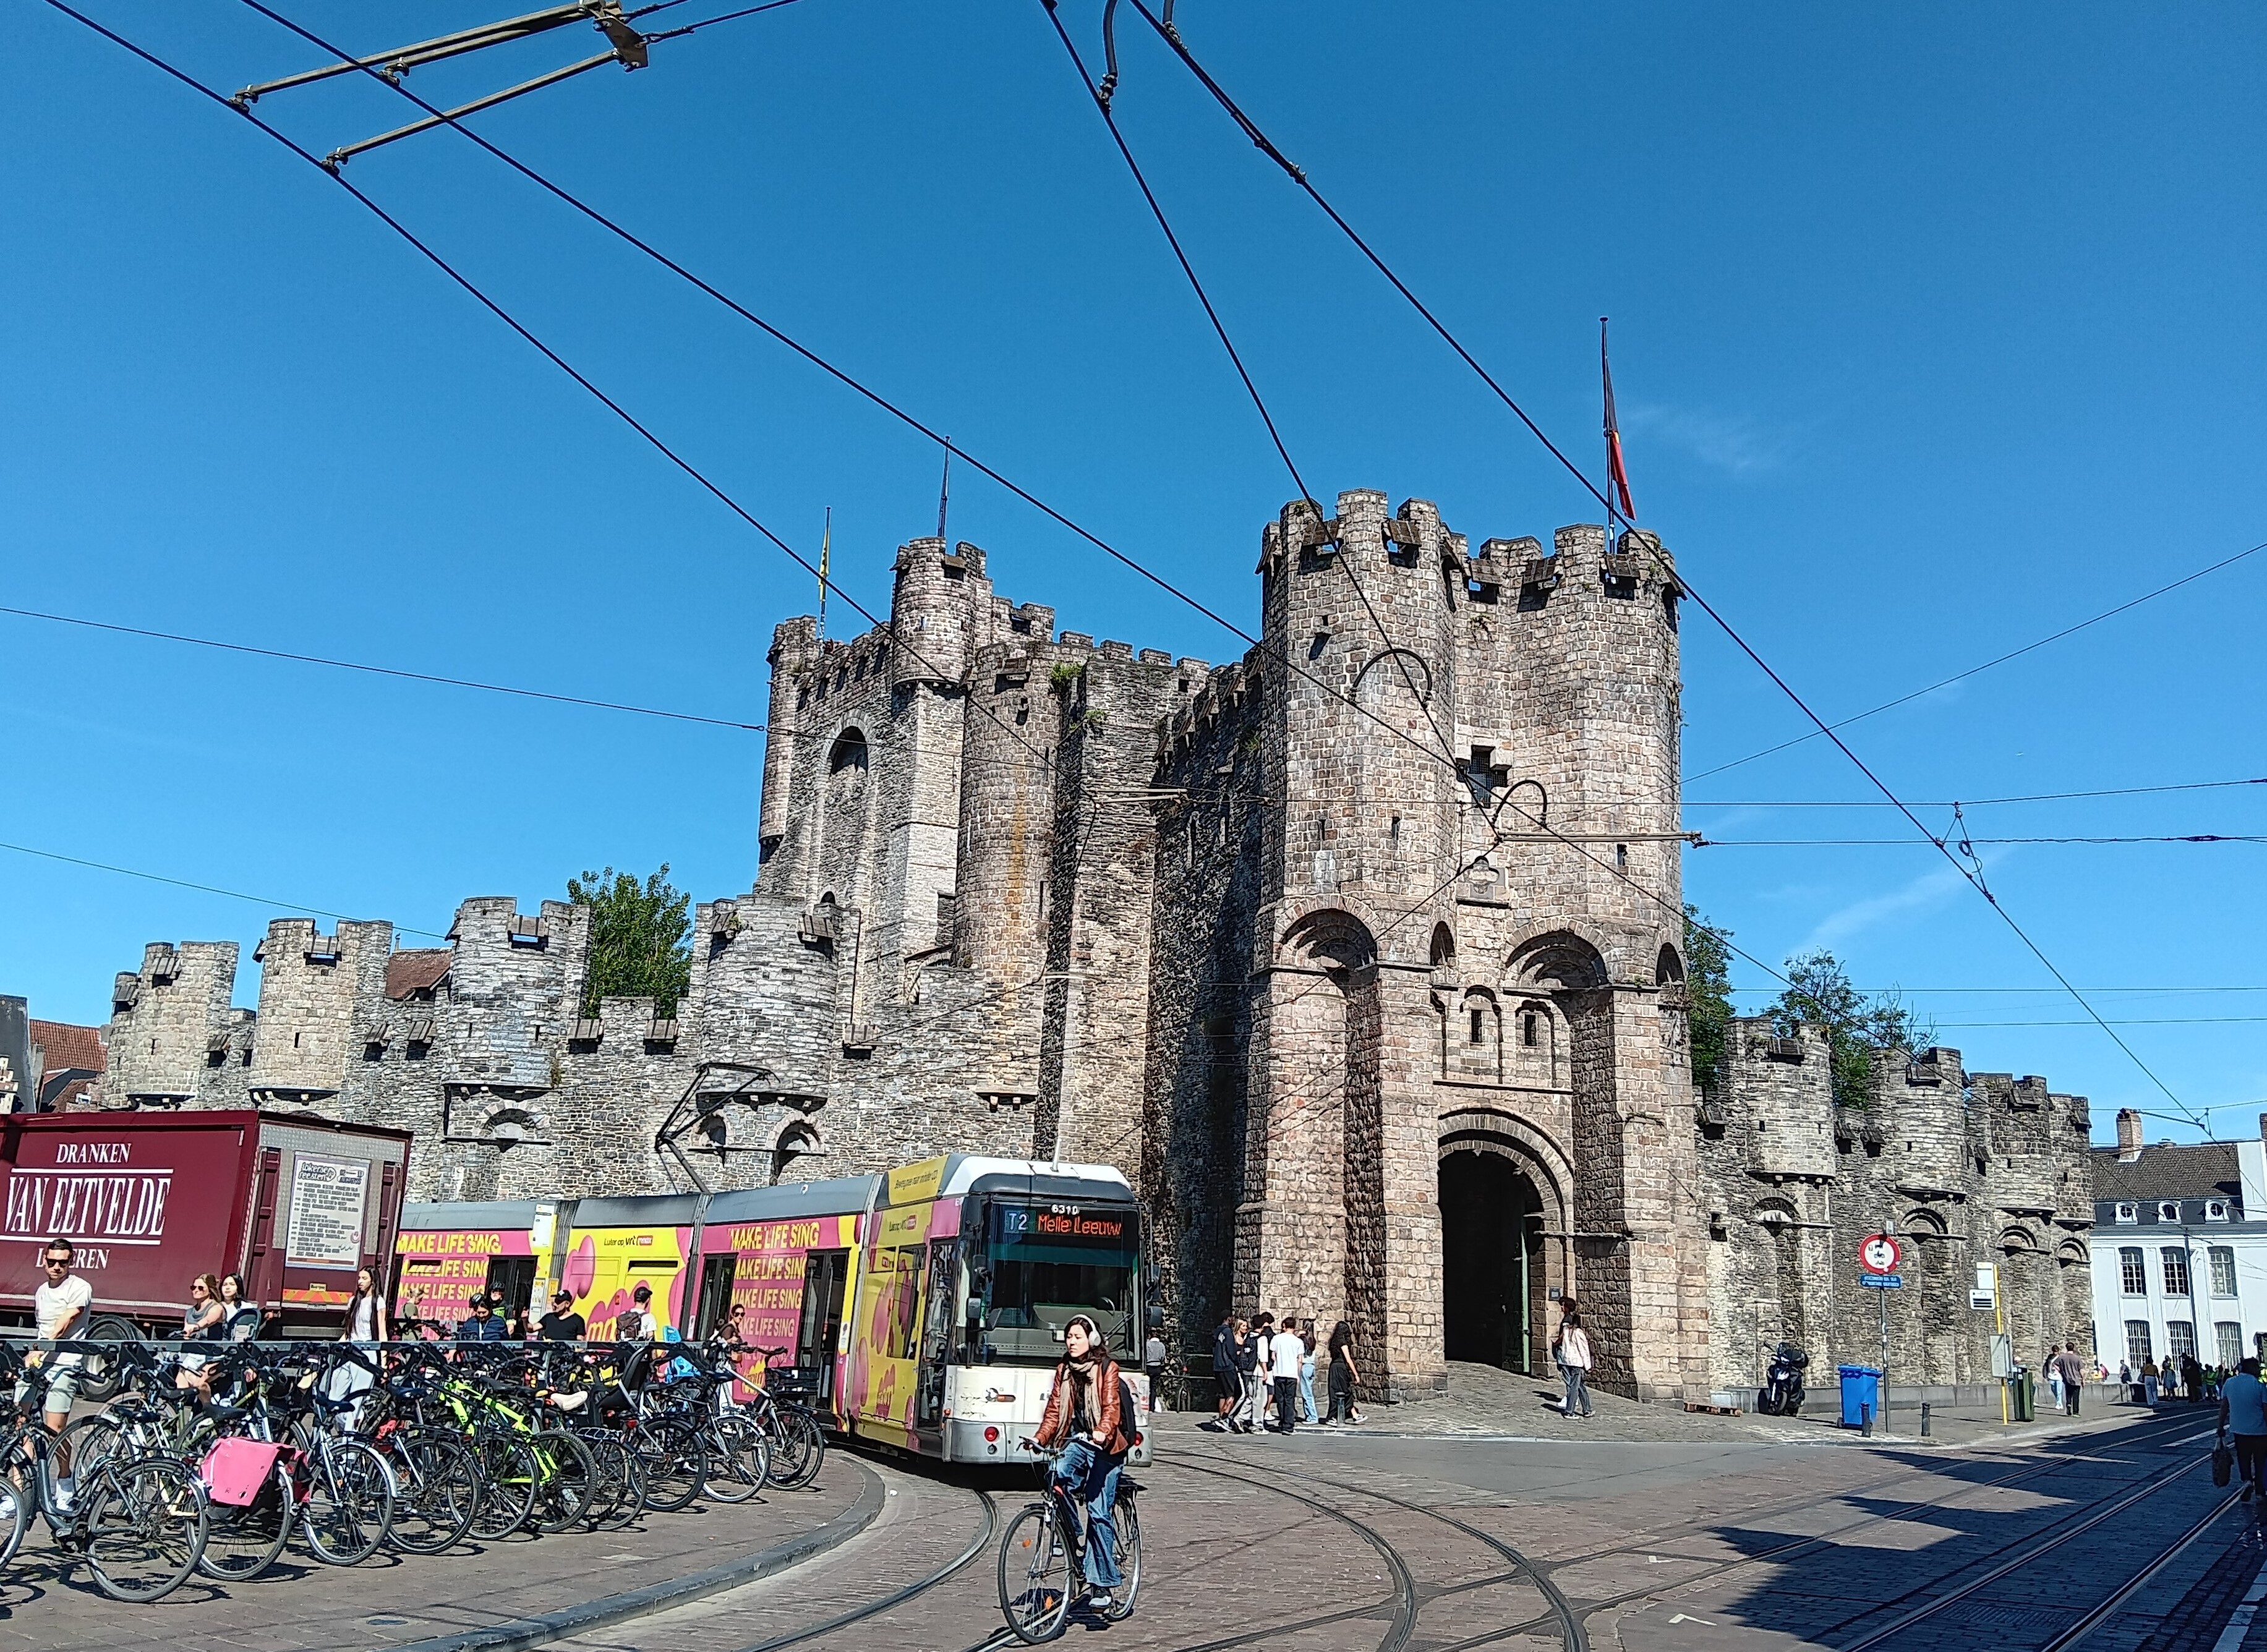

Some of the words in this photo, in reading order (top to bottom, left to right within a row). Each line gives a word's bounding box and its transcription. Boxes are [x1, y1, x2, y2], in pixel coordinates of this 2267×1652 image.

[56, 1143, 132, 1163] DRANKEN
[5, 1177, 49, 1233] VAN
[46, 1177, 171, 1235] EETVELDE
[1052, 1204, 1080, 1215] 6310
[1009, 1213, 1028, 1230] T2
[1038, 1214, 1071, 1233] Melle
[1074, 1216, 1122, 1235] Leeuw
[396, 1234, 436, 1254] MAKE
[437, 1234, 466, 1254] LIFE
[466, 1233, 503, 1254] SING
[730, 1227, 762, 1251] MAKE
[764, 1224, 789, 1250] LIFE
[790, 1222, 819, 1248] SING
[35, 1248, 110, 1269] LEREN
[761, 1258, 783, 1280] LIFE
[432, 1284, 456, 1300] LIFE
[731, 1288, 758, 1309] MAKE
[758, 1288, 779, 1309] LIFE
[779, 1288, 803, 1309] SING
[429, 1306, 451, 1321] LIFE
[754, 1318, 774, 1336] LIFE
[773, 1318, 795, 1337] SING
